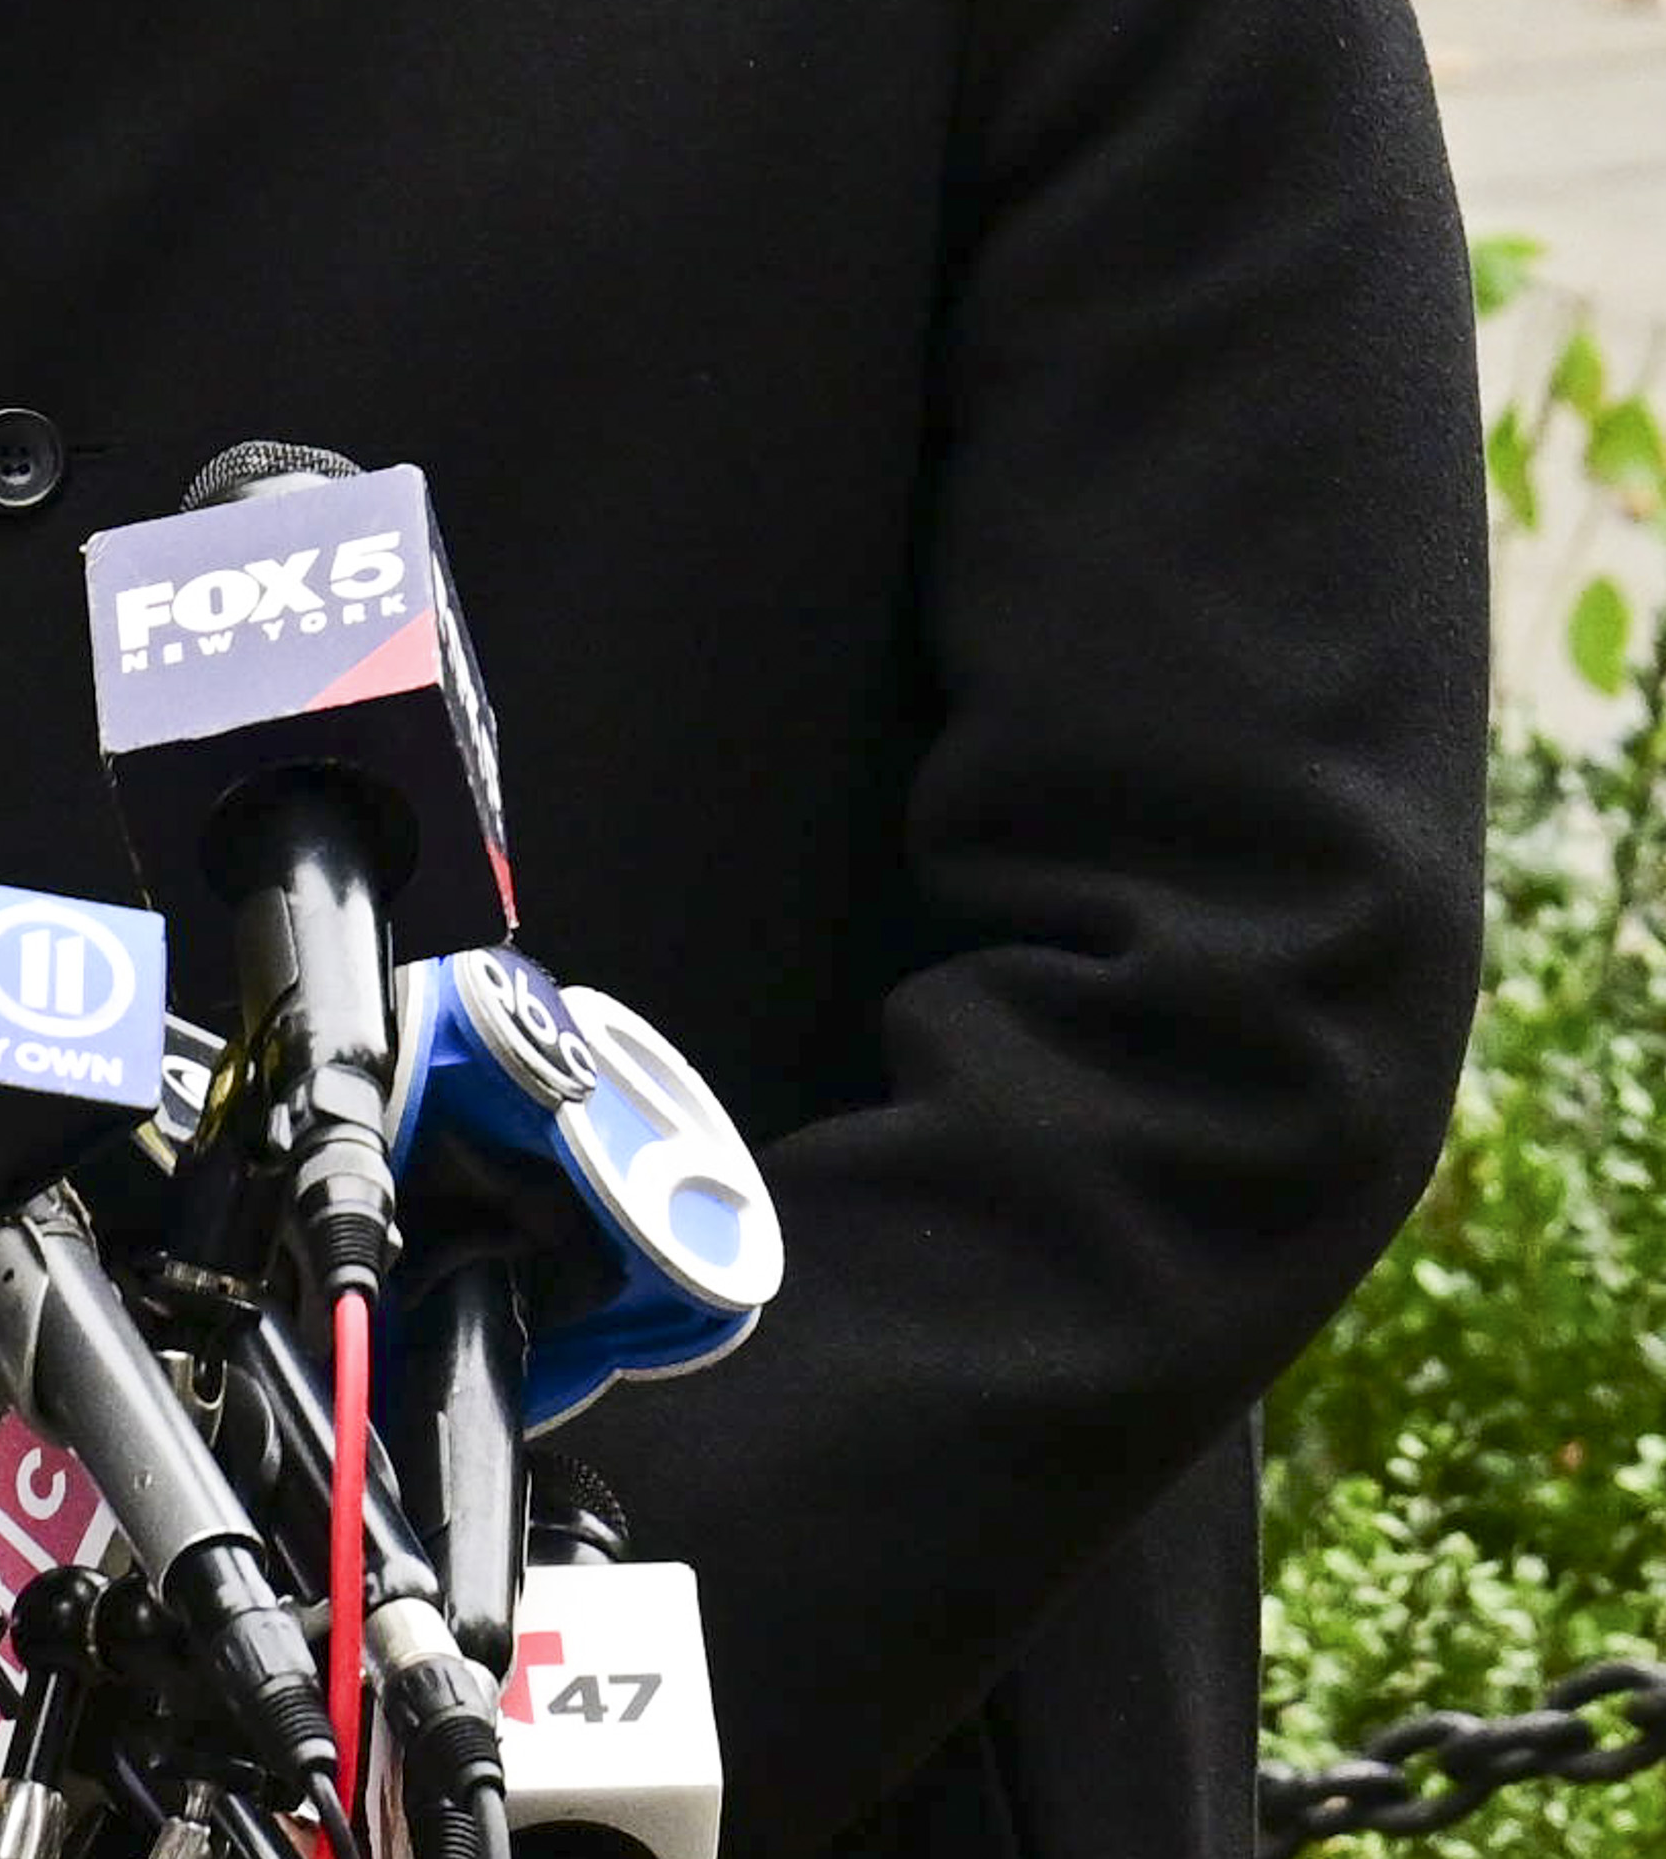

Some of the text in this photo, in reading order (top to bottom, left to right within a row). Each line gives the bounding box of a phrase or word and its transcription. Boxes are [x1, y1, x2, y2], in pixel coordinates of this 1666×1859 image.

[116, 531, 405, 651] FOX 5
[121, 593, 408, 673] NEW YORK
[18, 929, 84, 1015] 11
[15, 1041, 122, 1086] OWN
[548, 1673, 662, 1723] 47
